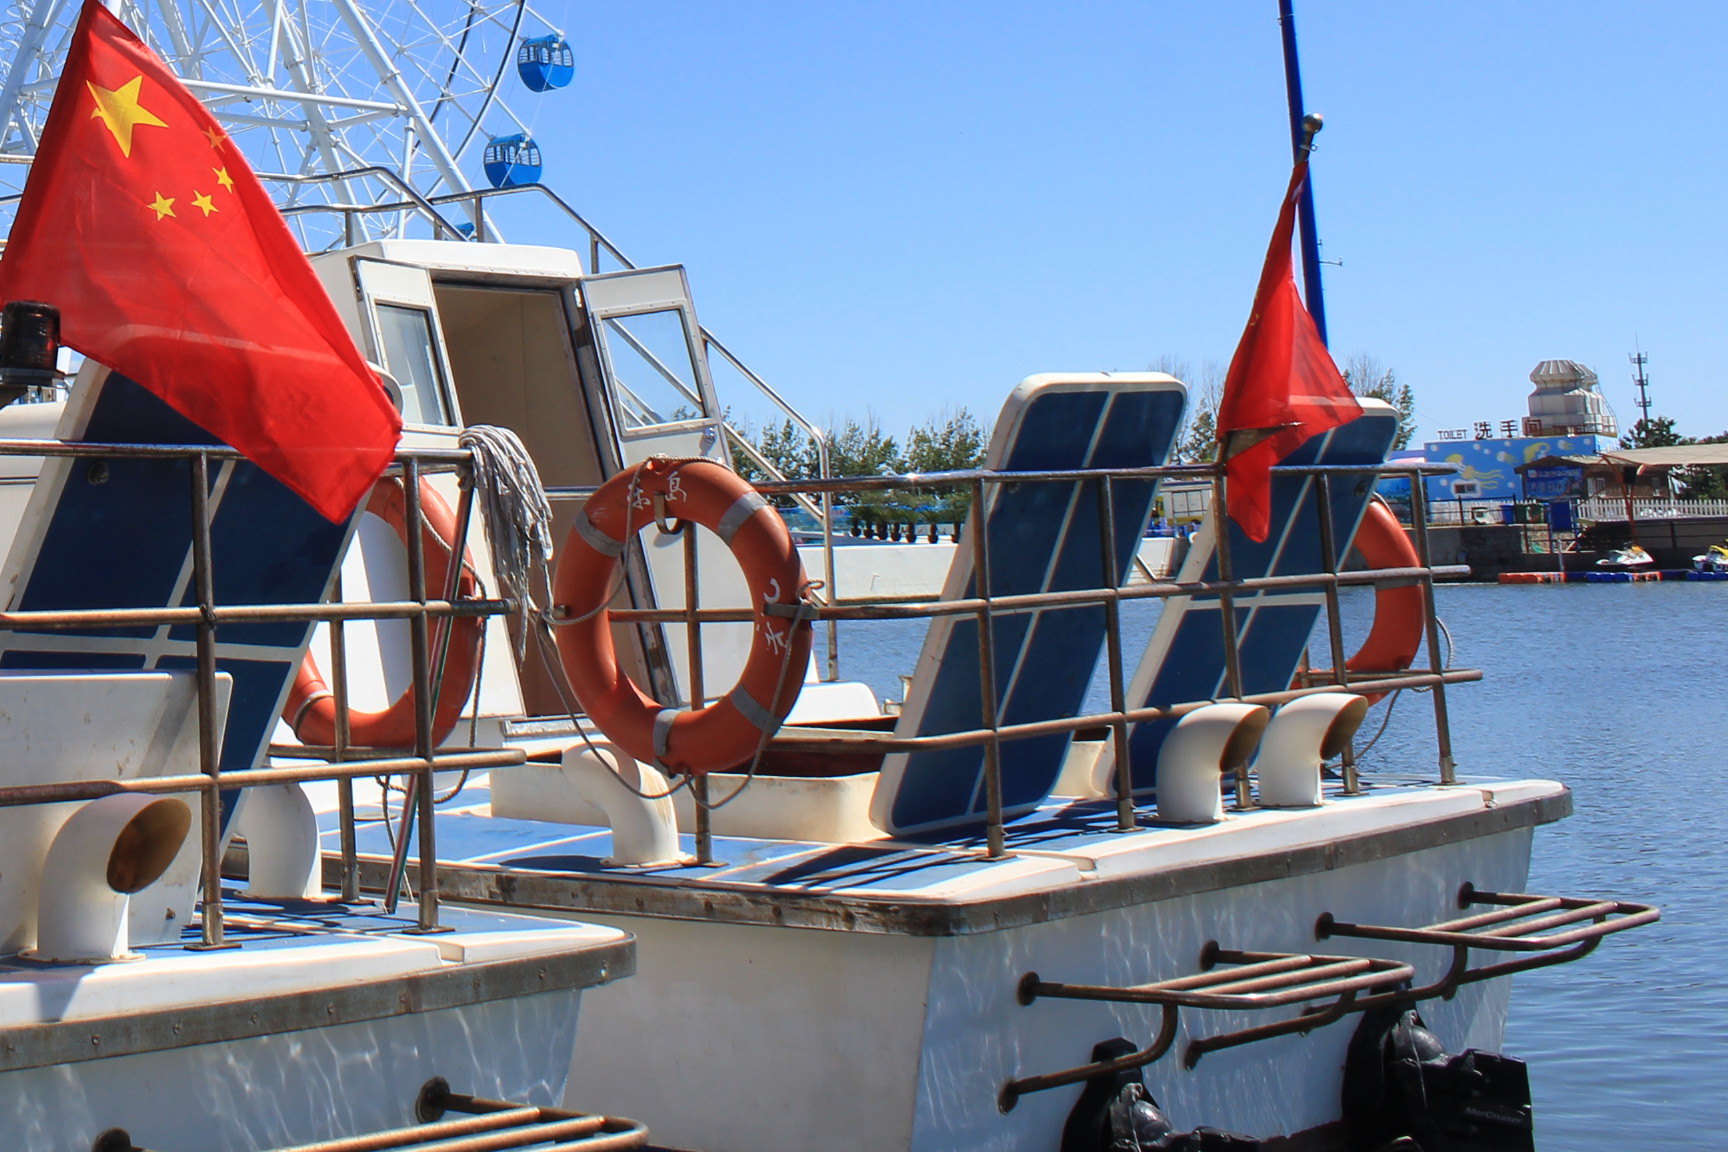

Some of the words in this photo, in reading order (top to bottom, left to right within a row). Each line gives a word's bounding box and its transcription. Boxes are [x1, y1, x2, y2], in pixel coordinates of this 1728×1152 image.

[1438, 430, 1467, 440] TOILET
[1474, 420, 1542, 440] 洗手间
[1465, 1106, 1521, 1125] MerCruiser
